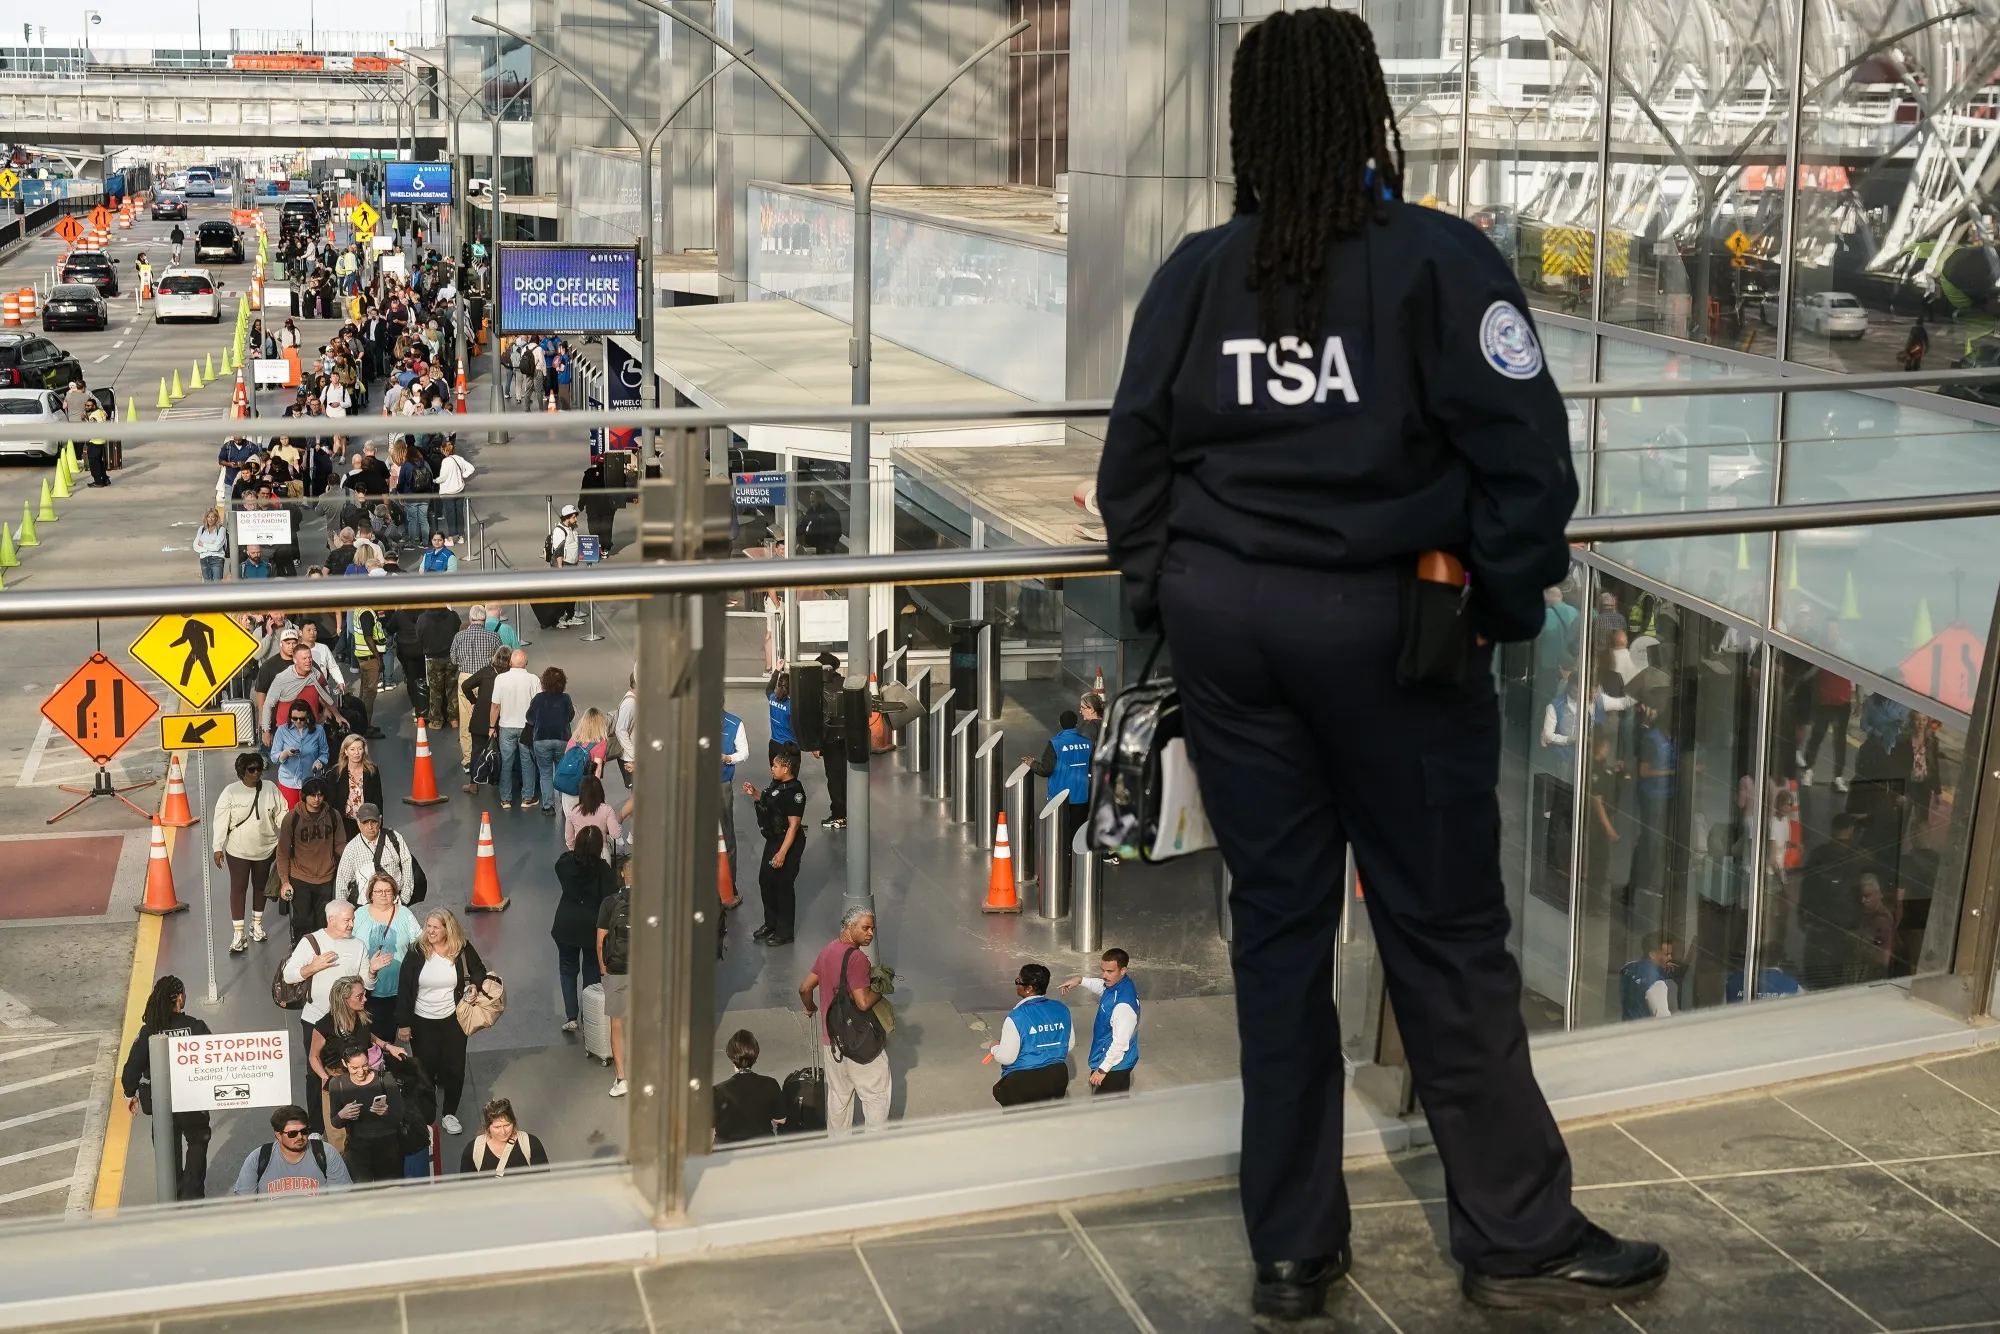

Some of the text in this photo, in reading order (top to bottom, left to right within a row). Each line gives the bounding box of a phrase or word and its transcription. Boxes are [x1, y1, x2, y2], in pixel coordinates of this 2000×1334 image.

[514, 277, 620, 291] DROP OFF HERE
[521, 293, 617, 306] FOR CHECK-IN
[1222, 336, 1360, 405] TSA
[736, 488, 770, 496] CURBSIDE
[736, 496, 770, 504] CHECK-IN
[772, 701, 787, 711] DELTA
[301, 824, 332, 841] GAP
[1038, 1022, 1064, 1032] DELTA
[178, 1037, 282, 1052] NO STOPPING
[178, 1050, 283, 1065] OR STANDING
[189, 1074, 222, 1082] Loading
[268, 1177, 320, 1194] AUBURN
